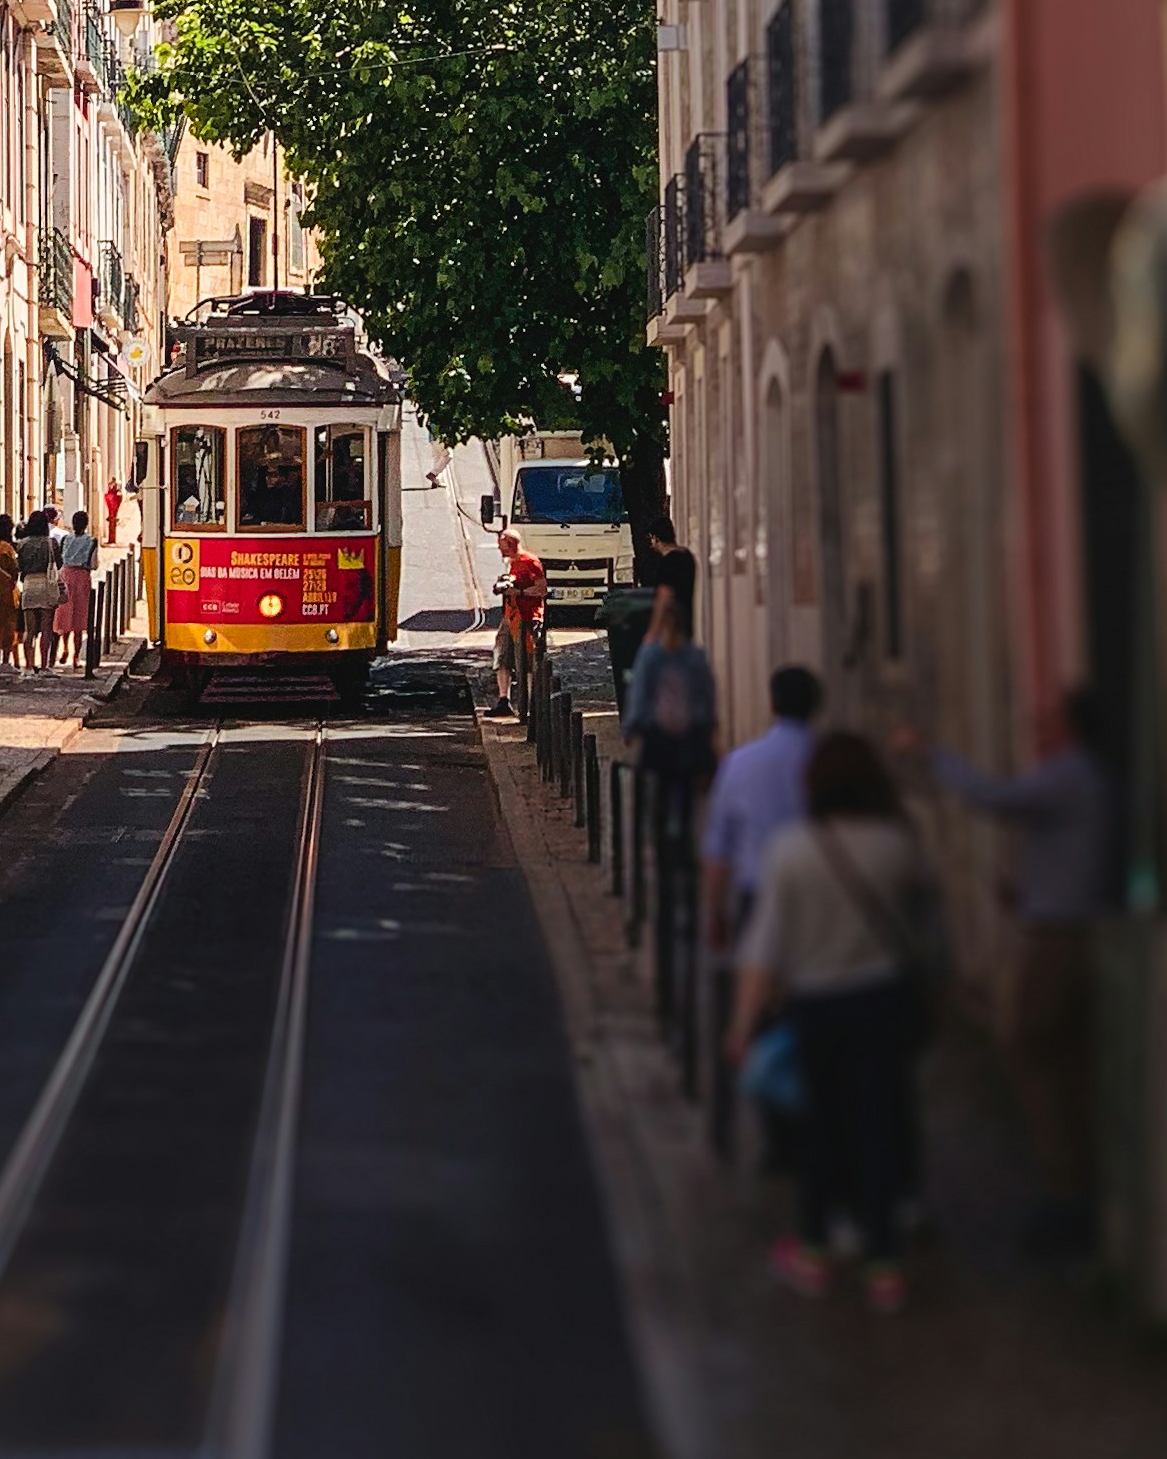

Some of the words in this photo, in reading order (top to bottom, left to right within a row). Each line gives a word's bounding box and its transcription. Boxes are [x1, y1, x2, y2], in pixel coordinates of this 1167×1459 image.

[204, 336, 286, 349] PRAZERES
[260, 409, 281, 420] 542
[230, 550, 300, 567] SHAKESPEARE
[217, 566, 228, 579] DA
[259, 567, 273, 580] EM
[301, 603, 329, 616] CCB.PT
